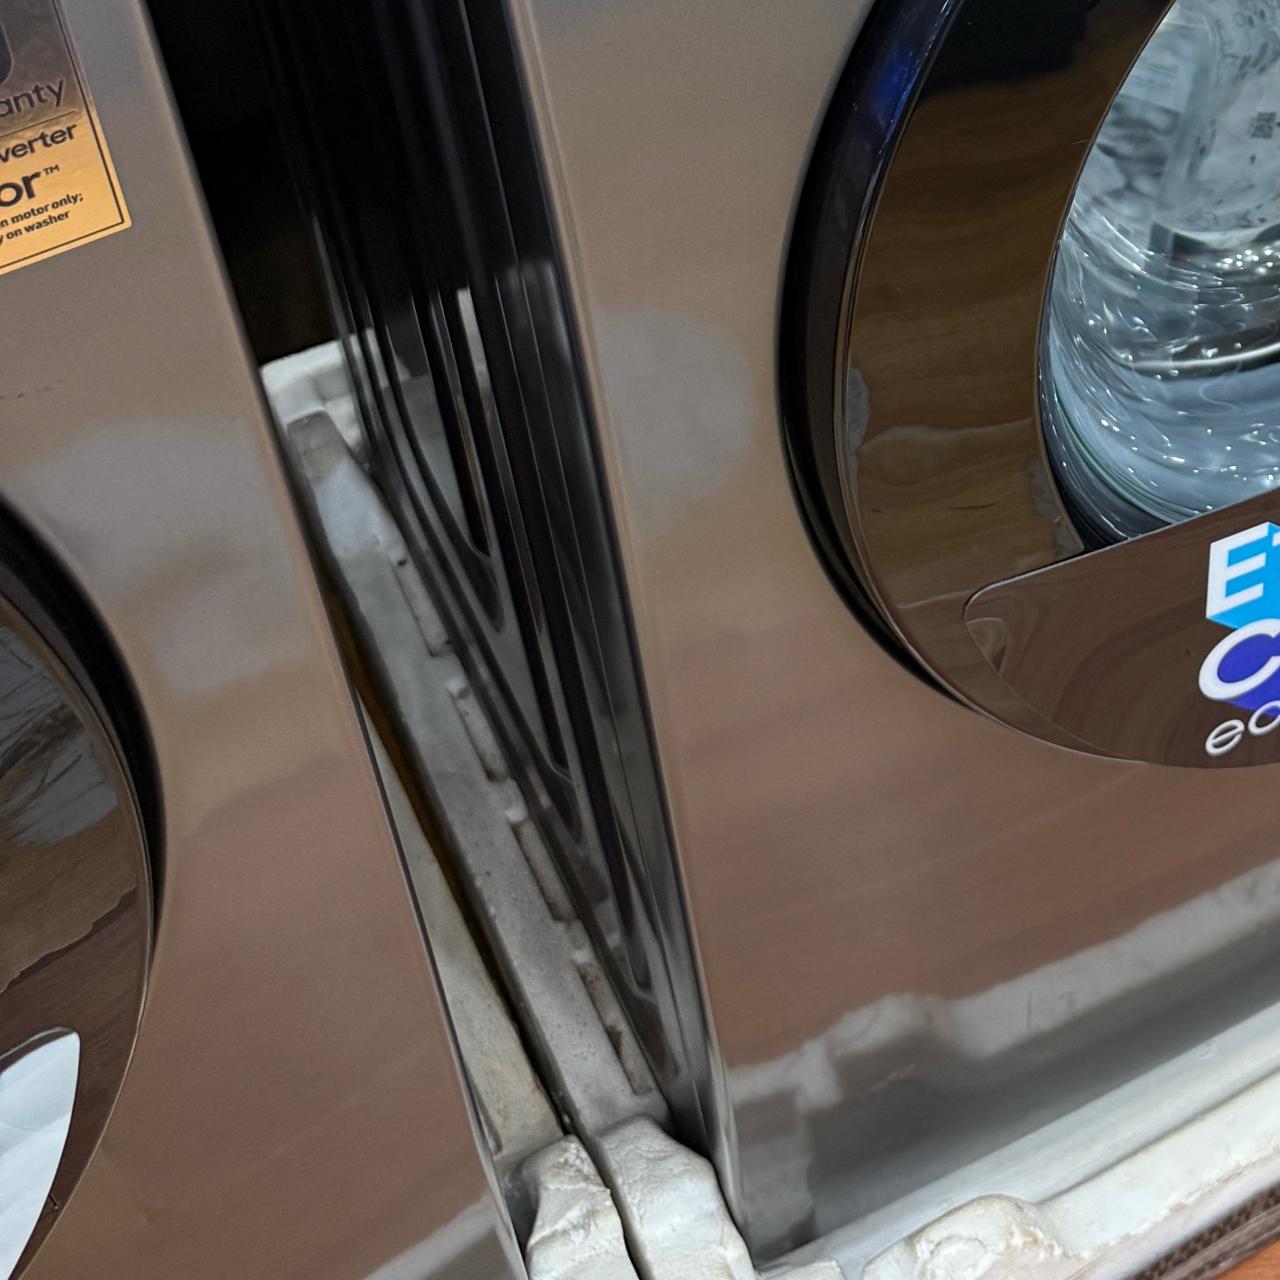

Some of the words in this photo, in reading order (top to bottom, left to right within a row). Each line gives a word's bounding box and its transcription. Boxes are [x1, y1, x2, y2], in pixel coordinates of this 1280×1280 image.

[11, 204, 50, 224] motor
[51, 193, 84, 209] only;
[6, 229, 23, 240] on
[24, 211, 71, 233] washer
